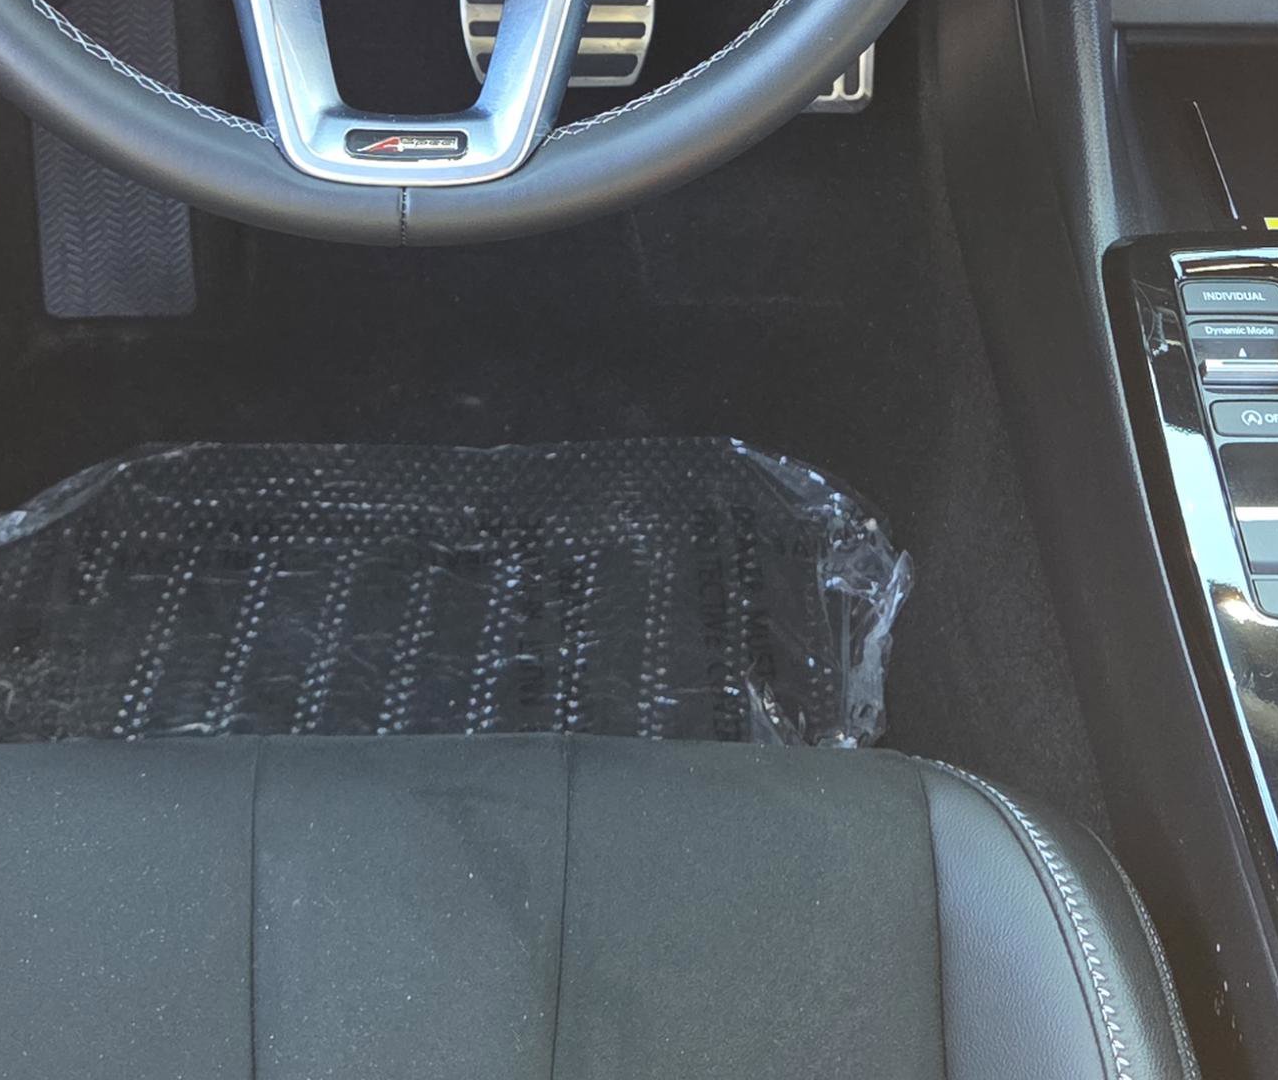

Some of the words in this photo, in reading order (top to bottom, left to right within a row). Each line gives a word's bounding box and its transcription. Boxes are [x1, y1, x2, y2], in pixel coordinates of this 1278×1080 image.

[1202, 291, 1266, 302] INDIVIDUAL
[1205, 326, 1246, 336] Dynamic
[1247, 326, 1274, 336] Mode
